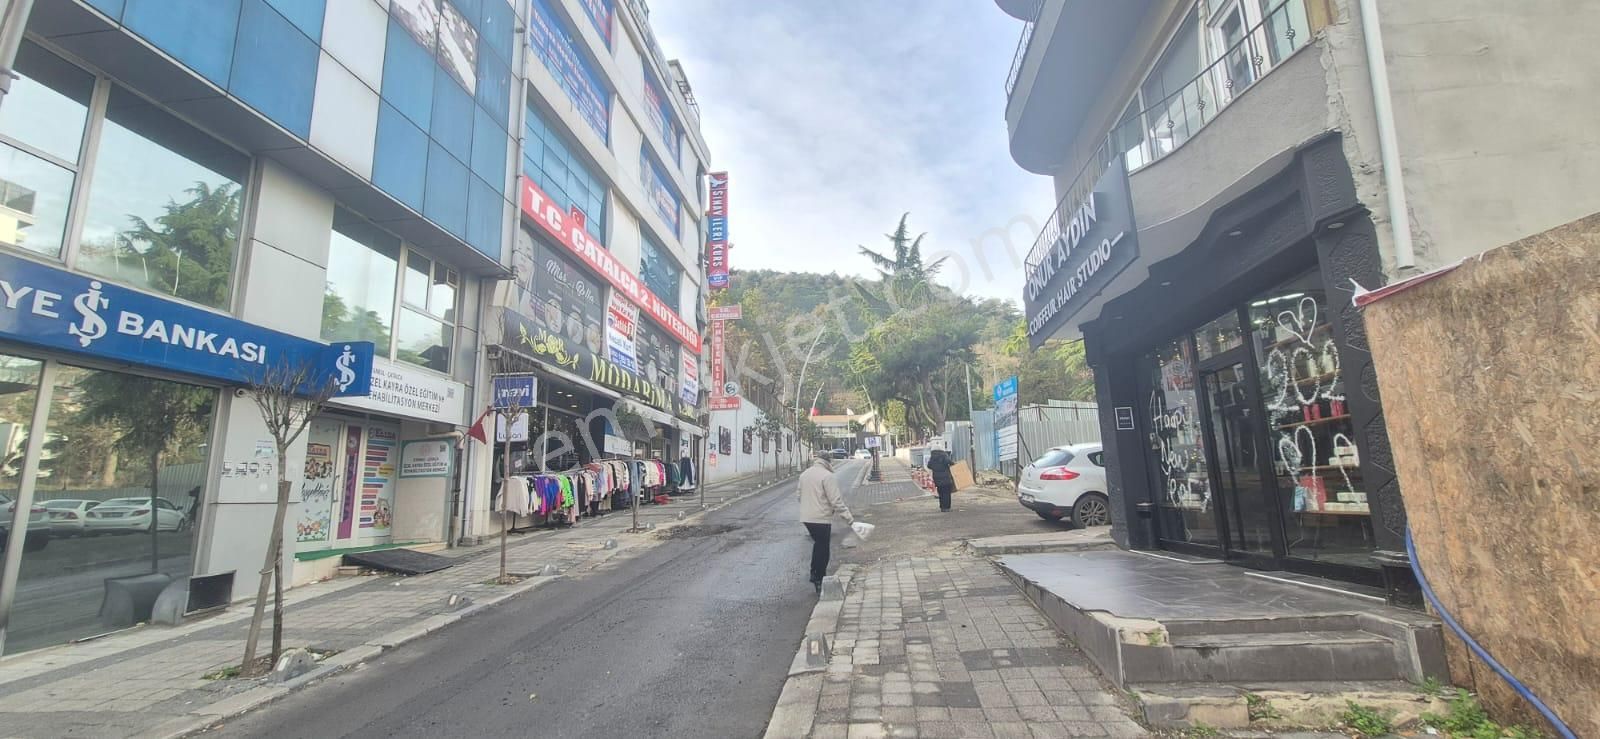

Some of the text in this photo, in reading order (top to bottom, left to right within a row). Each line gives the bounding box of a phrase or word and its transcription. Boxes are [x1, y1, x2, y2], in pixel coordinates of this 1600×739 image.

[528, 186, 568, 238] T.C.
[571, 227, 640, 299] ÇATALCA
[640, 290, 652, 309] 2.
[712, 244, 723, 267] KURS
[1028, 191, 1097, 302] ONUR AYDIN
[1029, 238, 1111, 336] COIFFEUR HAIR STUDIO
[117, 310, 266, 365] BANKASI
[383, 380, 403, 393] KAYRA
[1150, 389, 1193, 445] Happy
[1160, 437, 1189, 473] New
